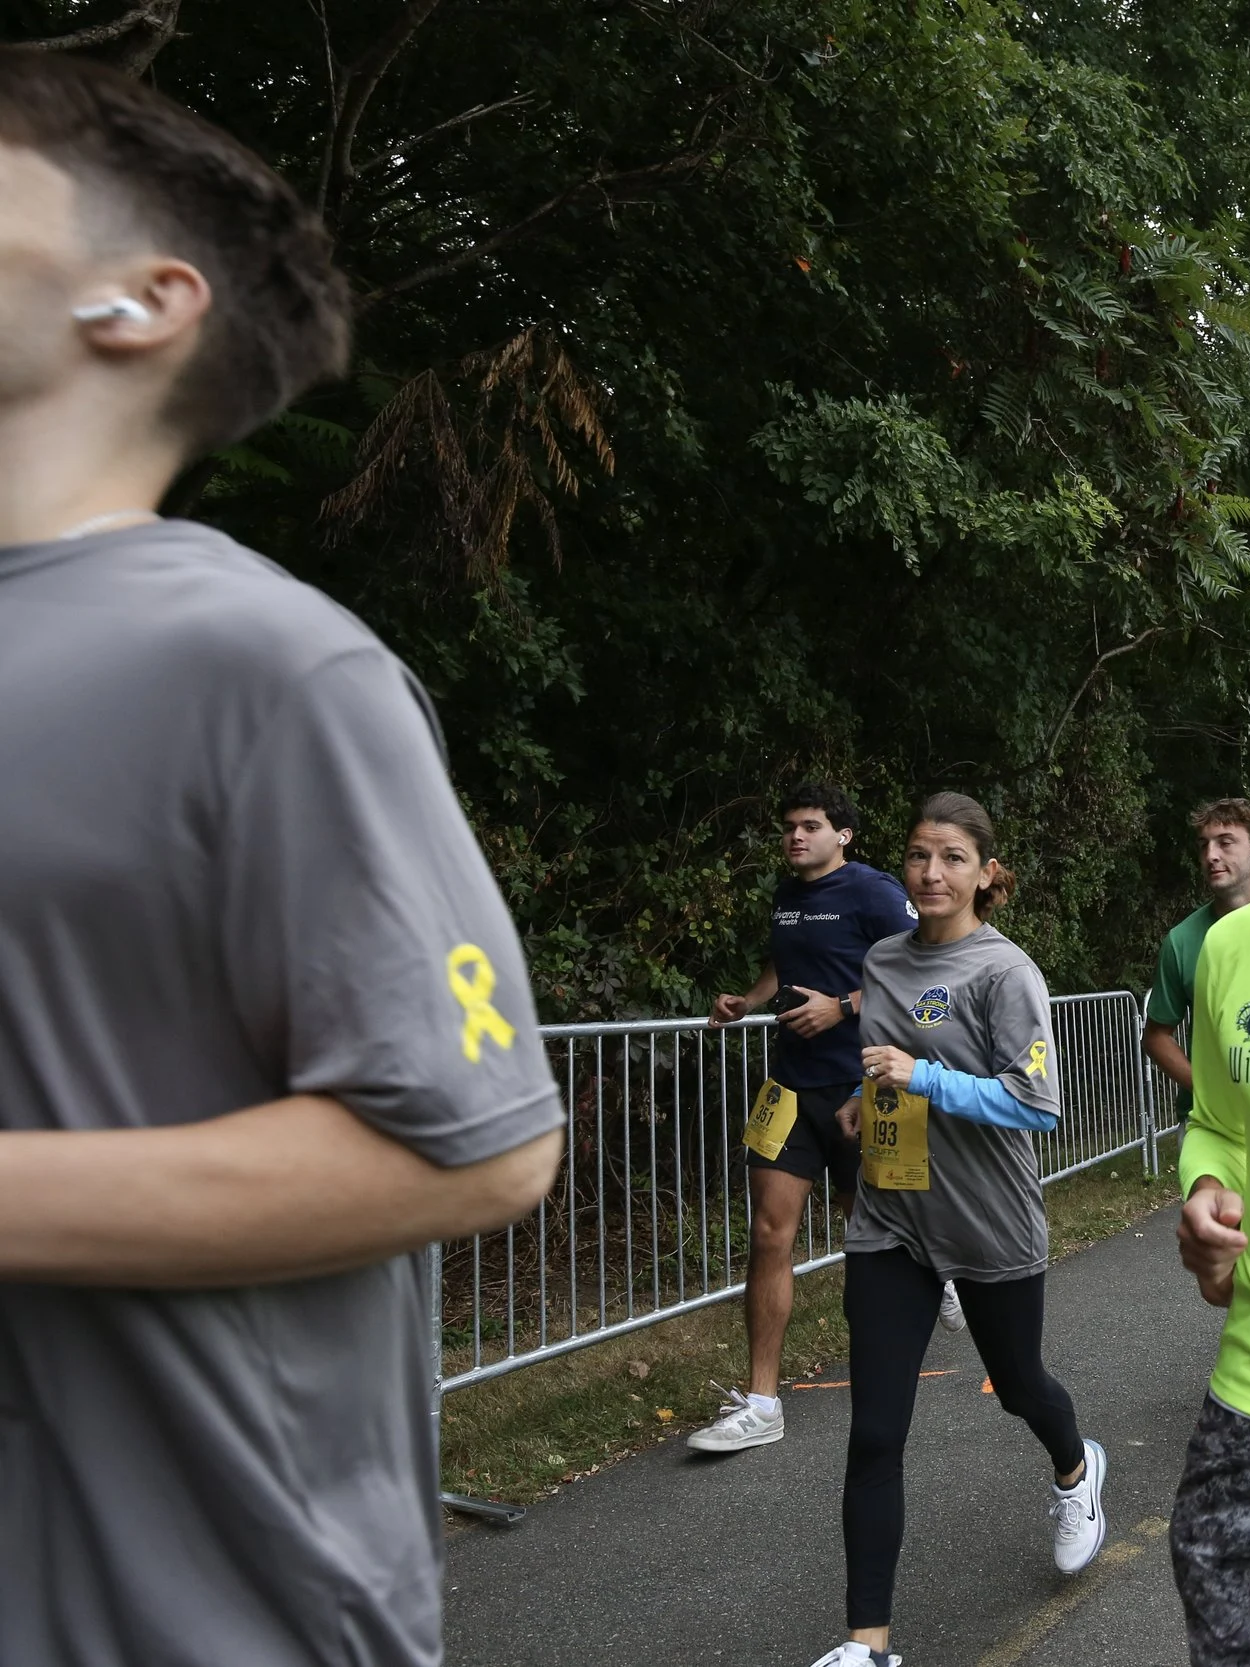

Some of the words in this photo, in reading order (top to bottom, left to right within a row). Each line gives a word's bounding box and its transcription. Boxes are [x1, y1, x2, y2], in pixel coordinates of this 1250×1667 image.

[803, 912, 840, 921] Foundation
[926, 1000, 947, 1010] STRONG
[755, 1104, 775, 1127] 351
[872, 1119, 898, 1147] 193
